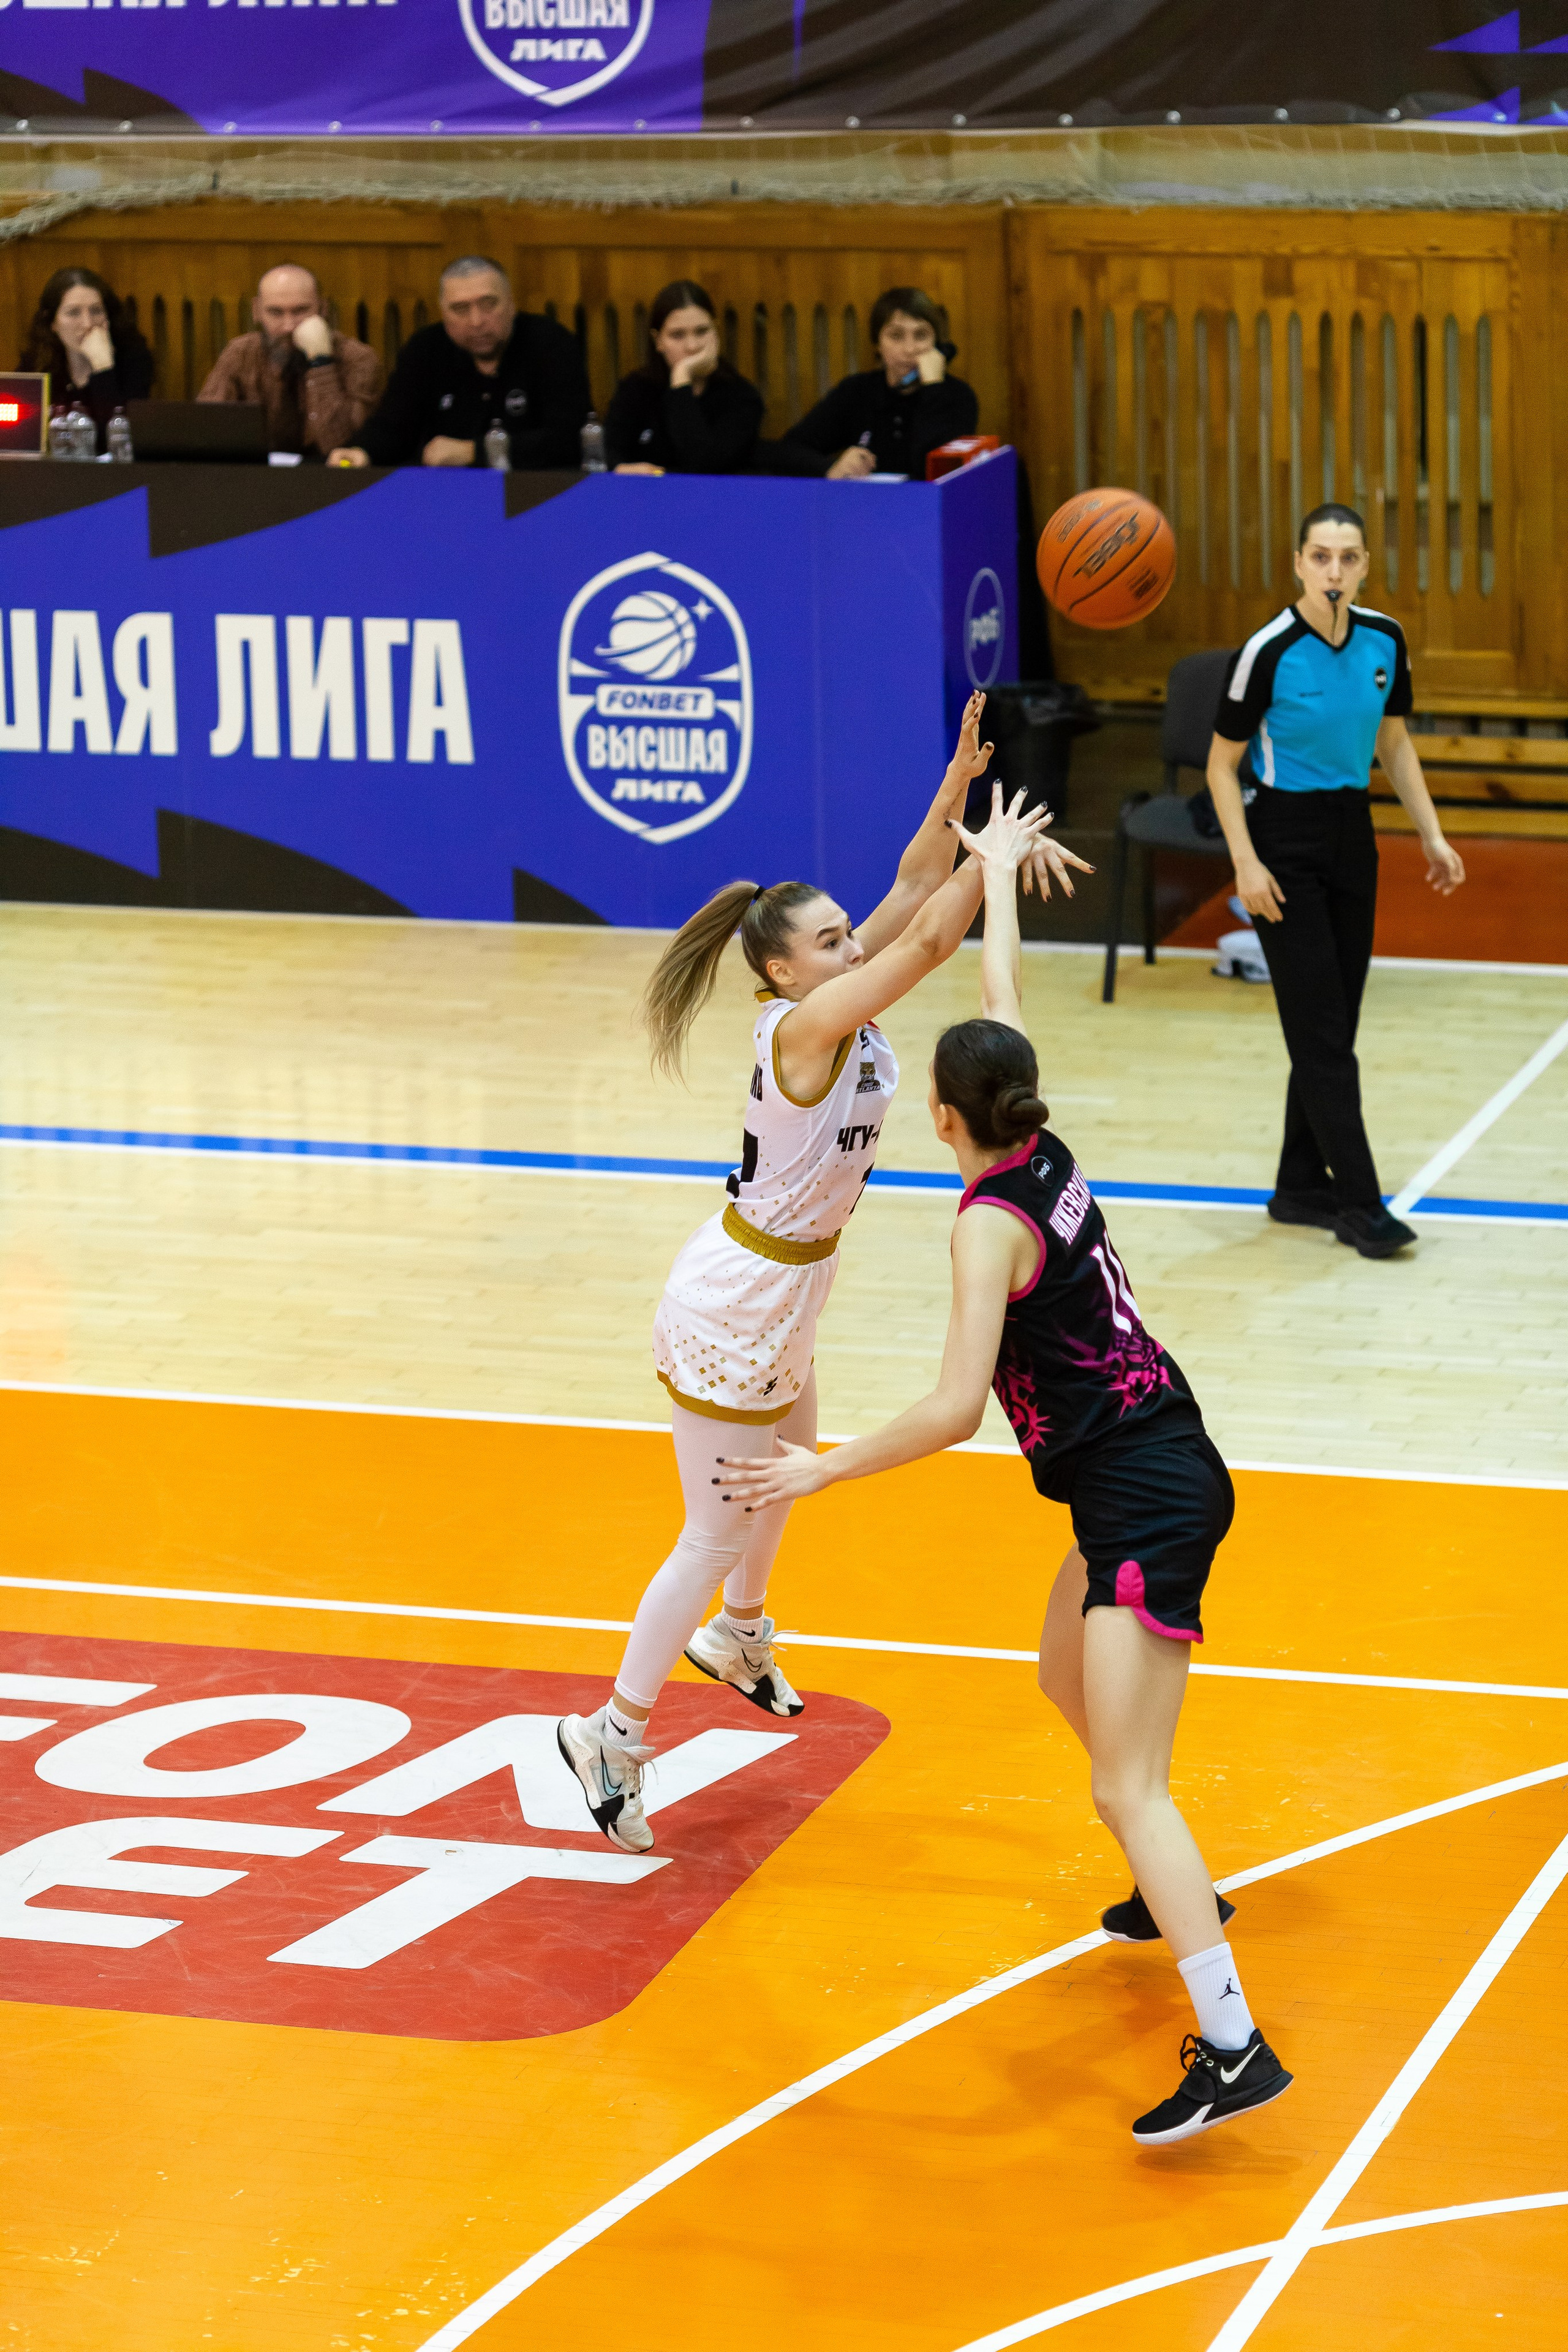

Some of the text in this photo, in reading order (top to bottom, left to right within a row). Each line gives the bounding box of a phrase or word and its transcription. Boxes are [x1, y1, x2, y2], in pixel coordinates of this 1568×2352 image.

[510, 38, 607, 62] ЛИГА
[209, 614, 475, 765] ЛИГА
[606, 690, 706, 712] FONBET
[587, 723, 728, 774] ВЫСШАЯ
[611, 777, 706, 804] ЛИГА
[837, 1118, 883, 1152] ЧГУ-
